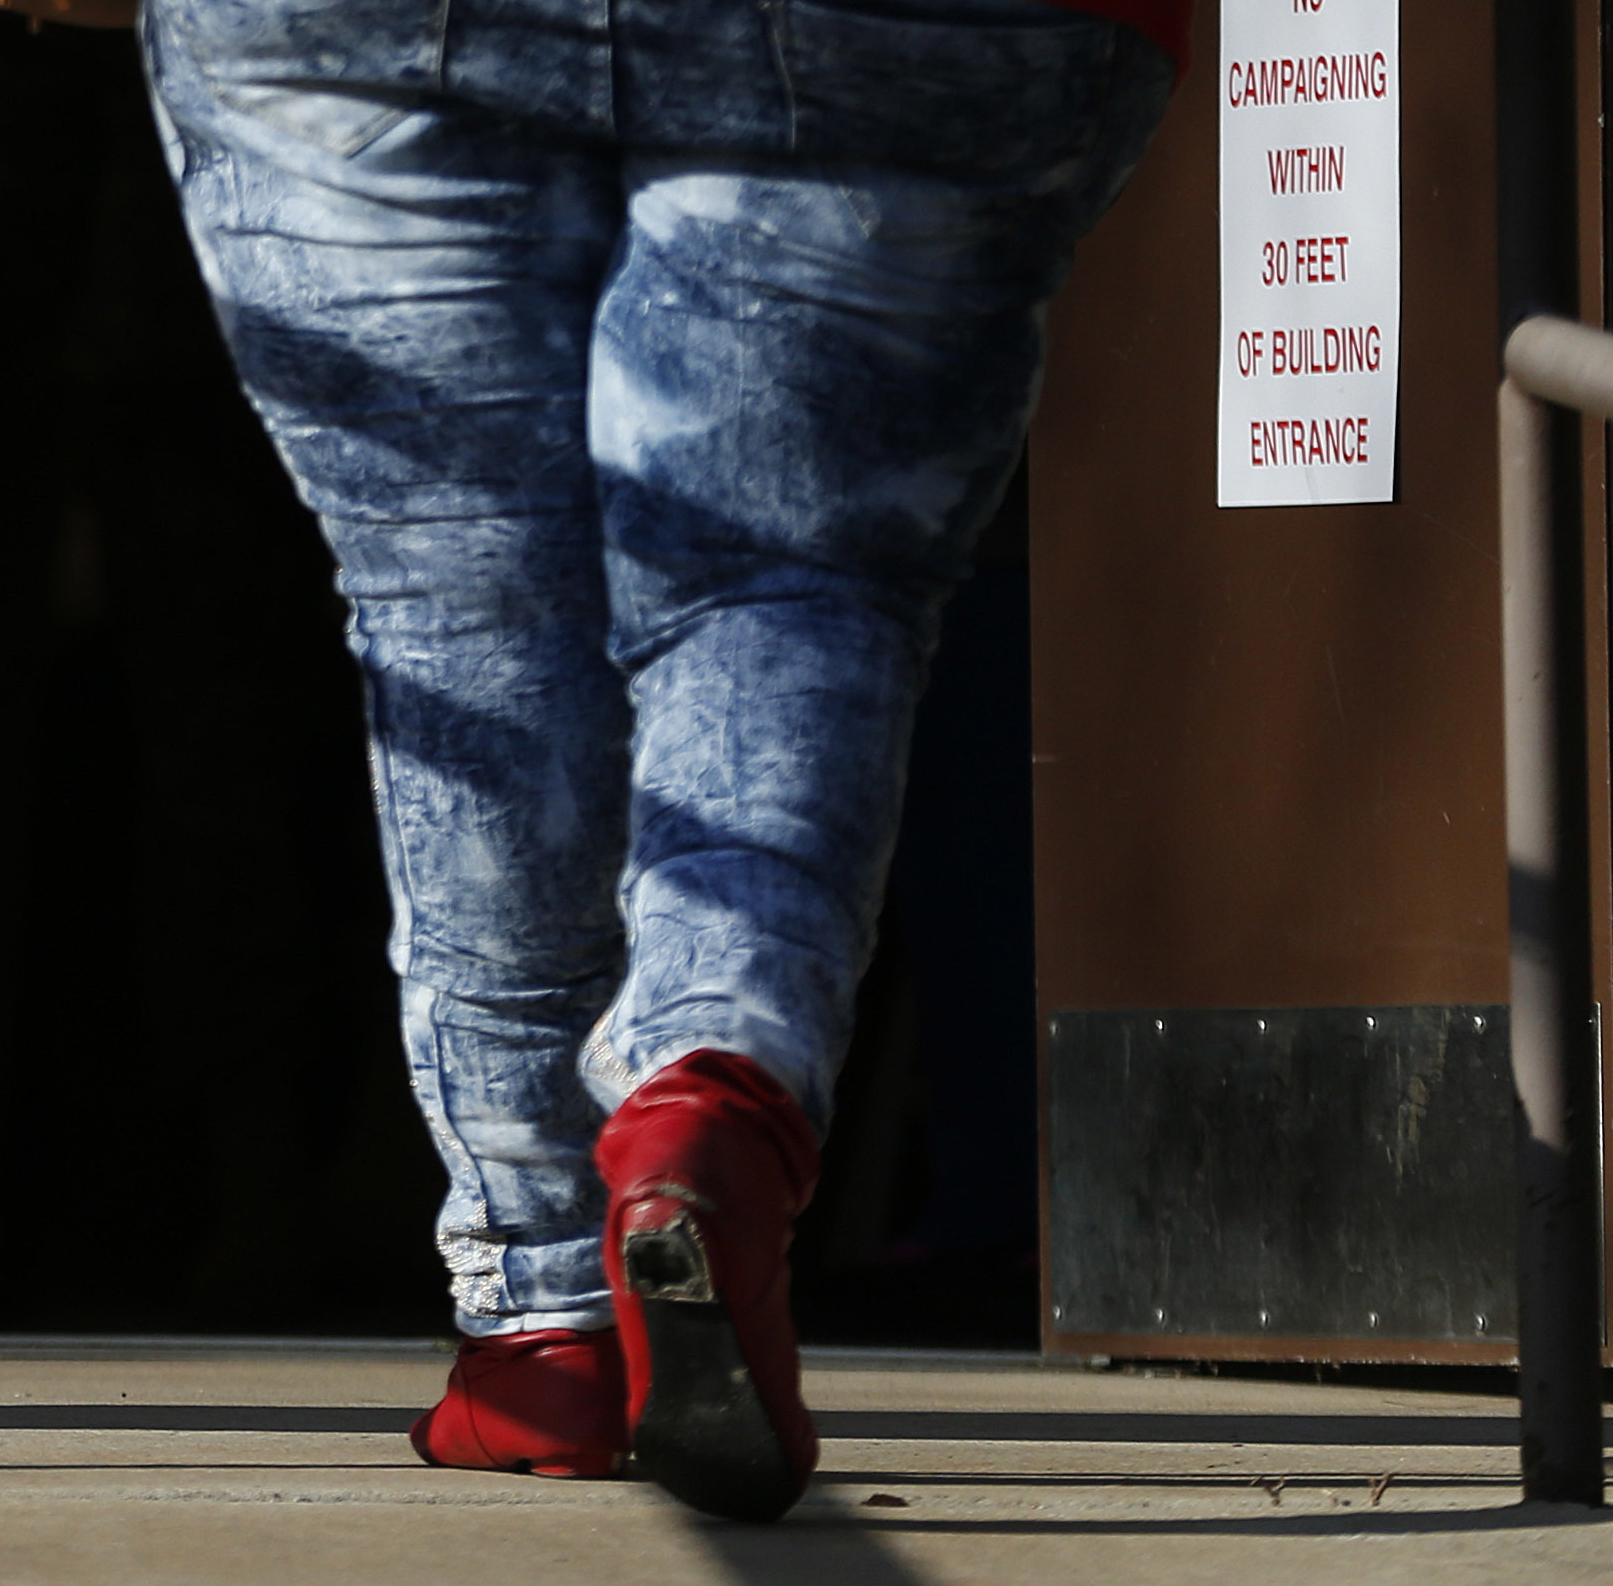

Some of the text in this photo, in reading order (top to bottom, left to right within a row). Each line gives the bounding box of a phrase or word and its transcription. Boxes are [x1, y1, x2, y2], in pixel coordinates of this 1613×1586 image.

[1228, 50, 1388, 108] CAMPAIGNING
[1267, 145, 1345, 196] WITHIN
[1261, 235, 1350, 287] 30 FEET
[1237, 324, 1382, 378] OF BUILDING
[1250, 416, 1369, 467] ENTRANCE
